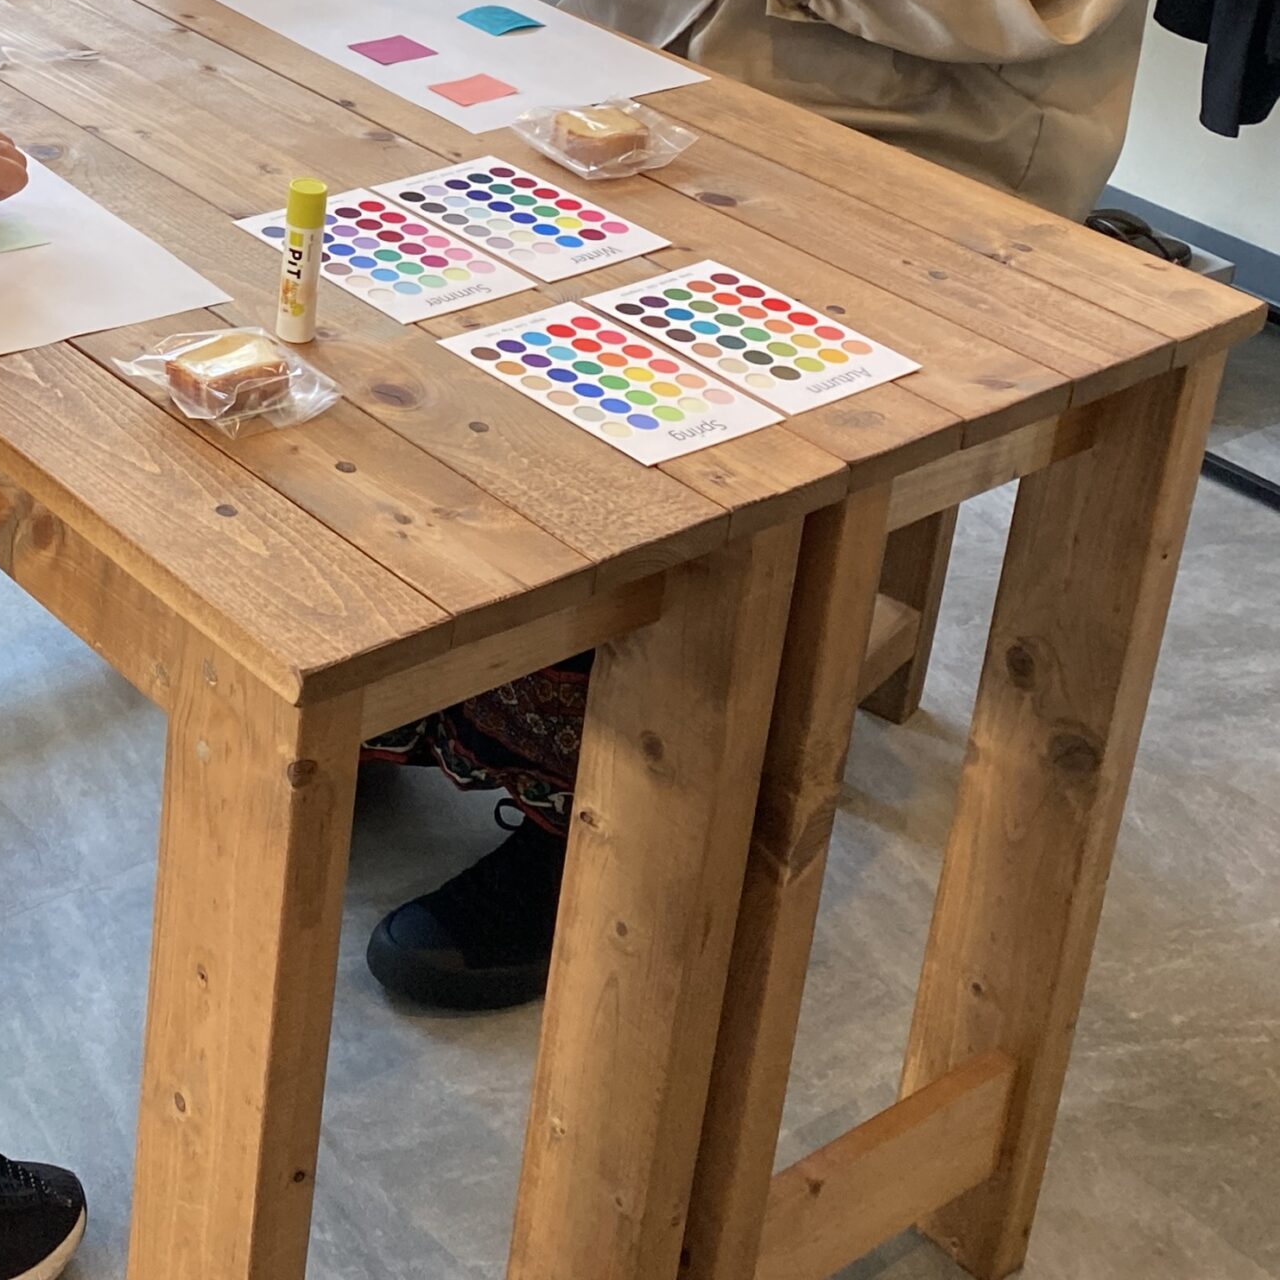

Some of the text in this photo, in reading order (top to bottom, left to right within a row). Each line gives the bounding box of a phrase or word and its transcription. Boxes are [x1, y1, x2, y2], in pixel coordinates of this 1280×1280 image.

[287, 247, 304, 280] PiT
[569, 246, 622, 266] Winter
[423, 282, 492, 308] Summer
[806, 366, 873, 396] Autumn
[667, 417, 728, 444] Spring
